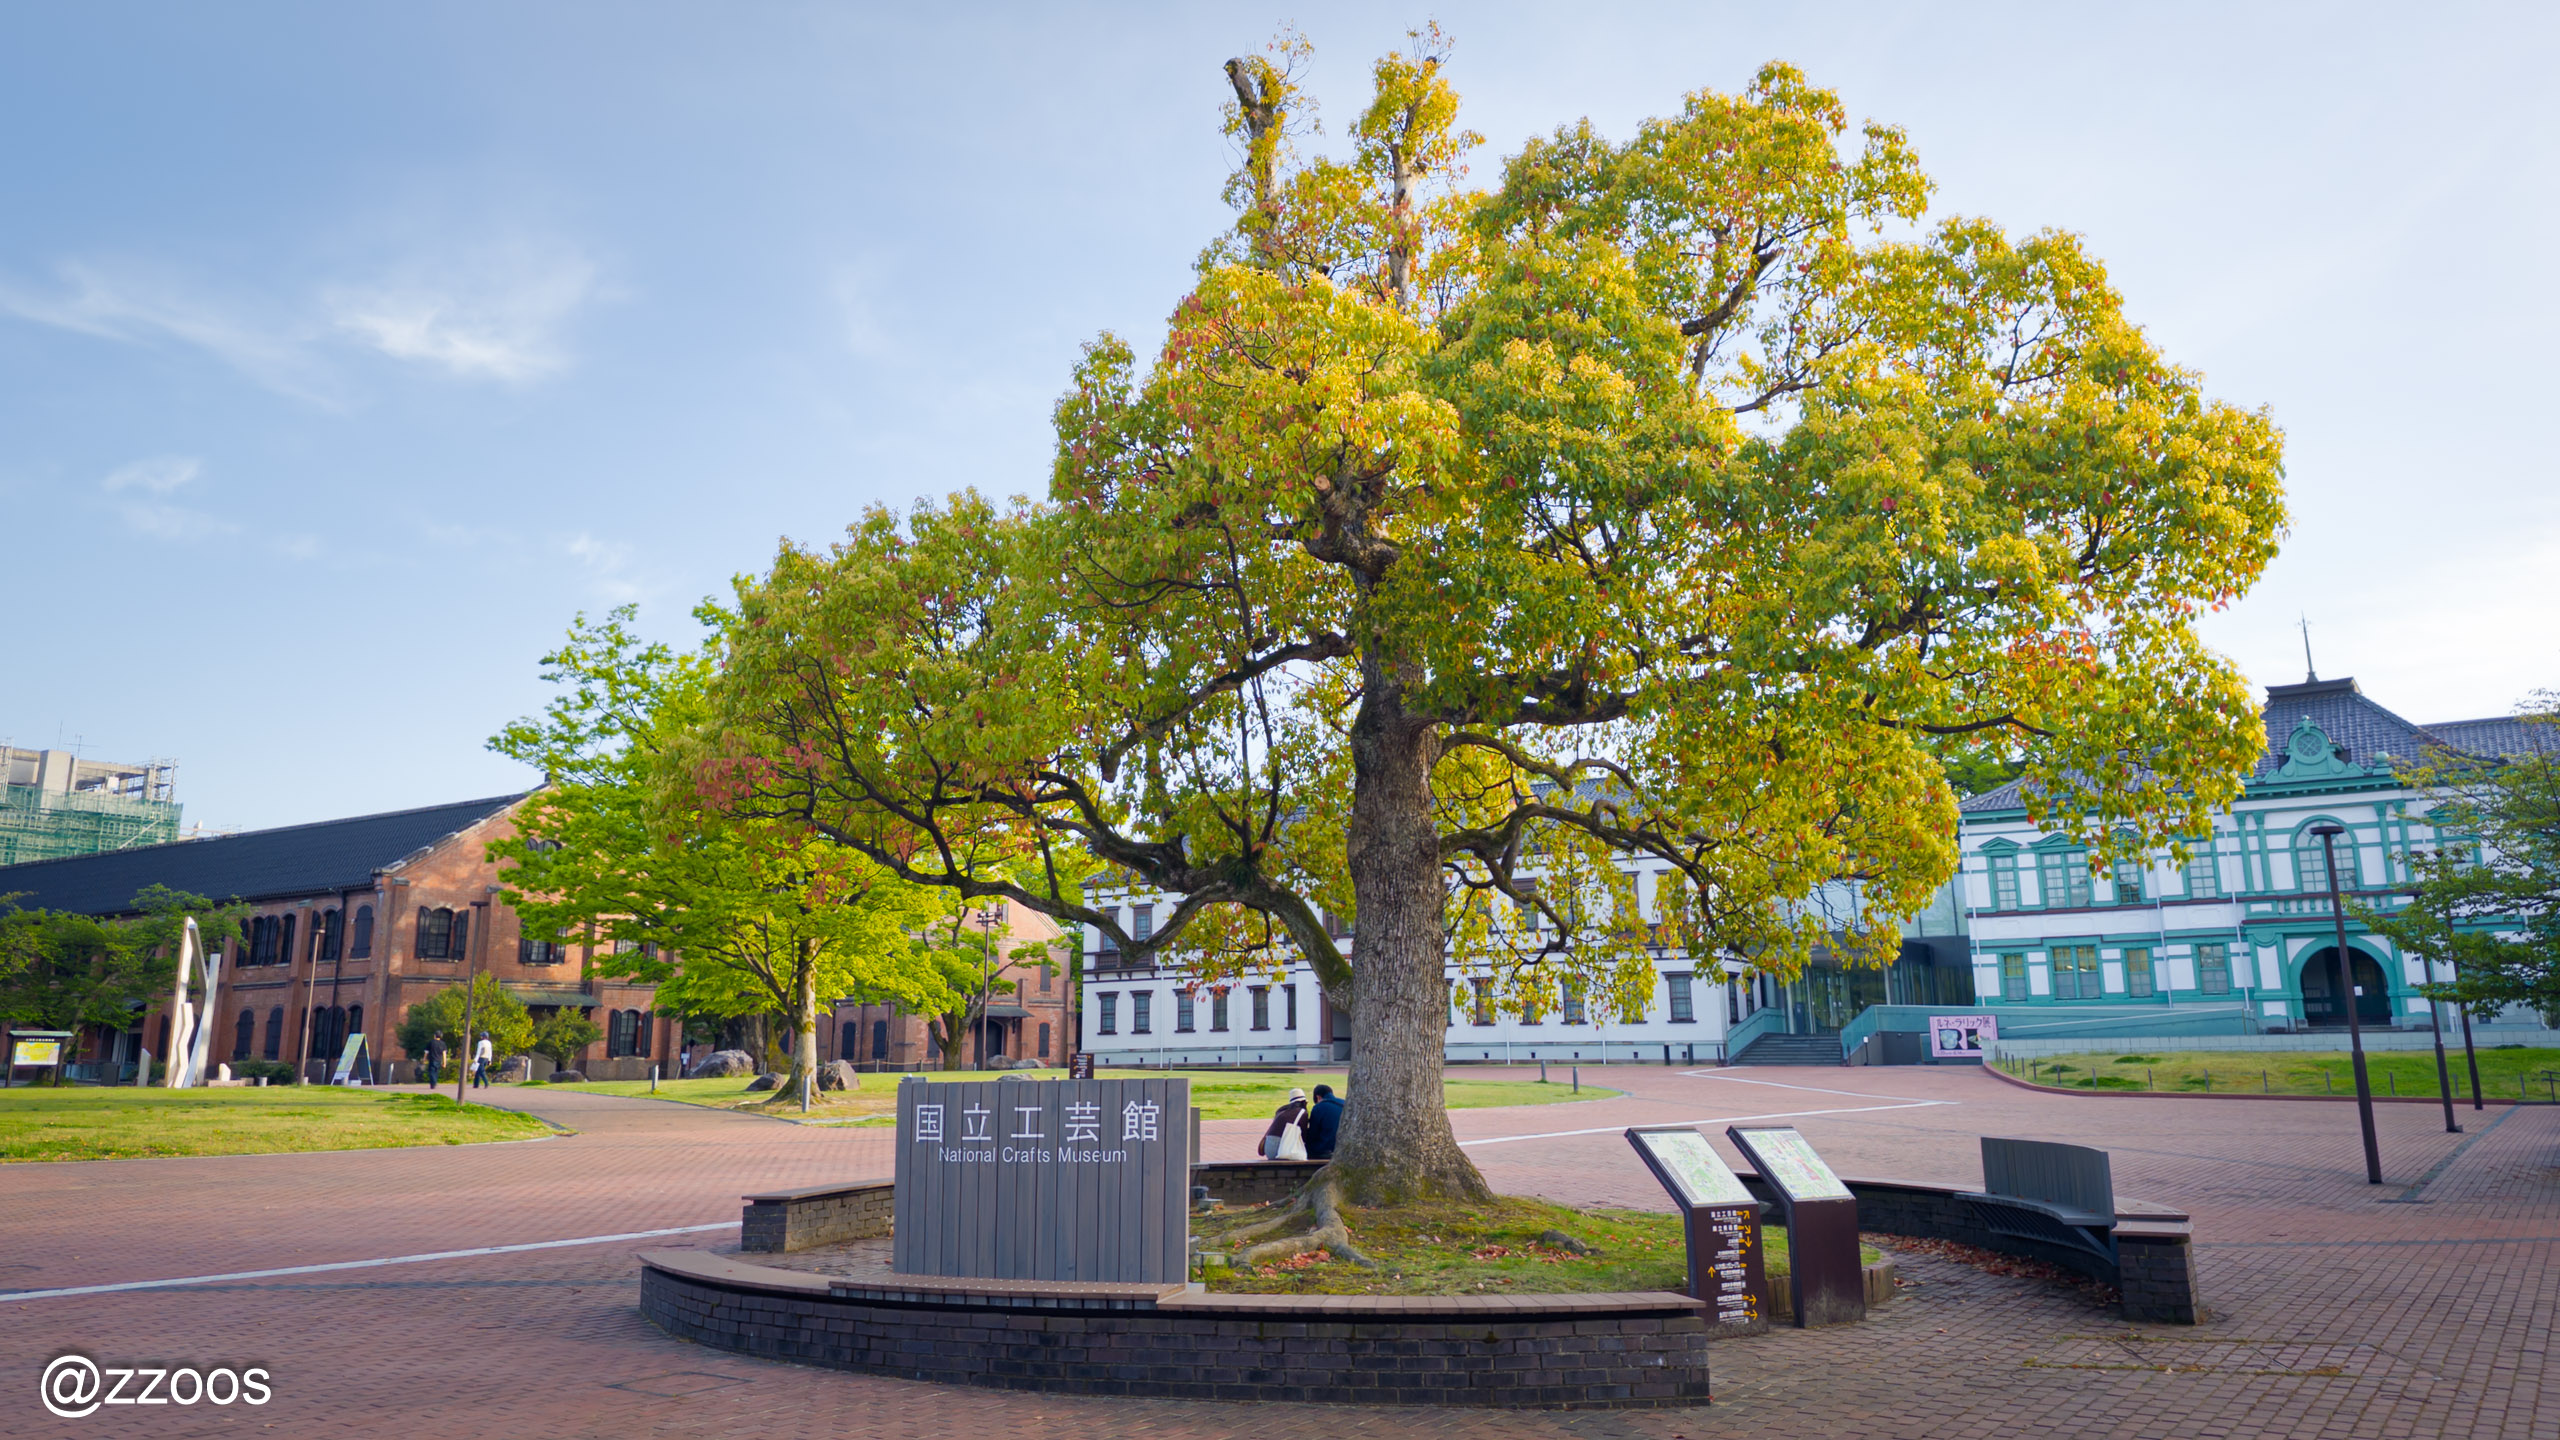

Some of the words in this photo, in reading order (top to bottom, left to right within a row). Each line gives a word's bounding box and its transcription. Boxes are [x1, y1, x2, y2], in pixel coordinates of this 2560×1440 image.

[915, 1099, 1160, 1143] 国立工芸館
[938, 1146, 996, 1163] National
[1002, 1146, 1051, 1163] Crafts
[1058, 1146, 1127, 1163] Museum
